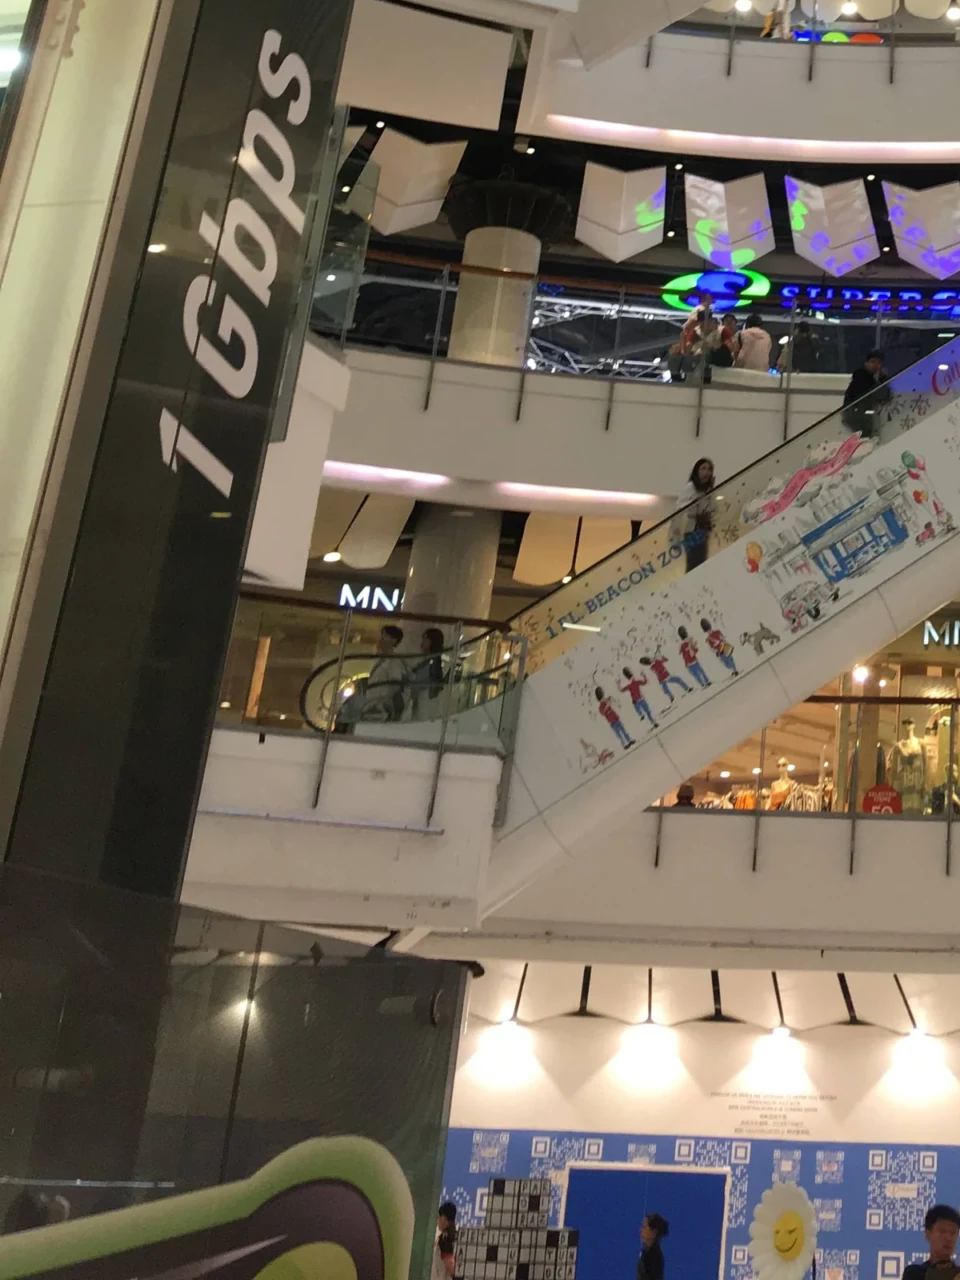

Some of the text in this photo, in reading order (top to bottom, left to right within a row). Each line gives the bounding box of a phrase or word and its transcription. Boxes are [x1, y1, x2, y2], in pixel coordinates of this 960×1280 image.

[159, 29, 312, 499] 1 Gbps
[545, 625, 559, 640] 1
[584, 561, 657, 614] BEACON
